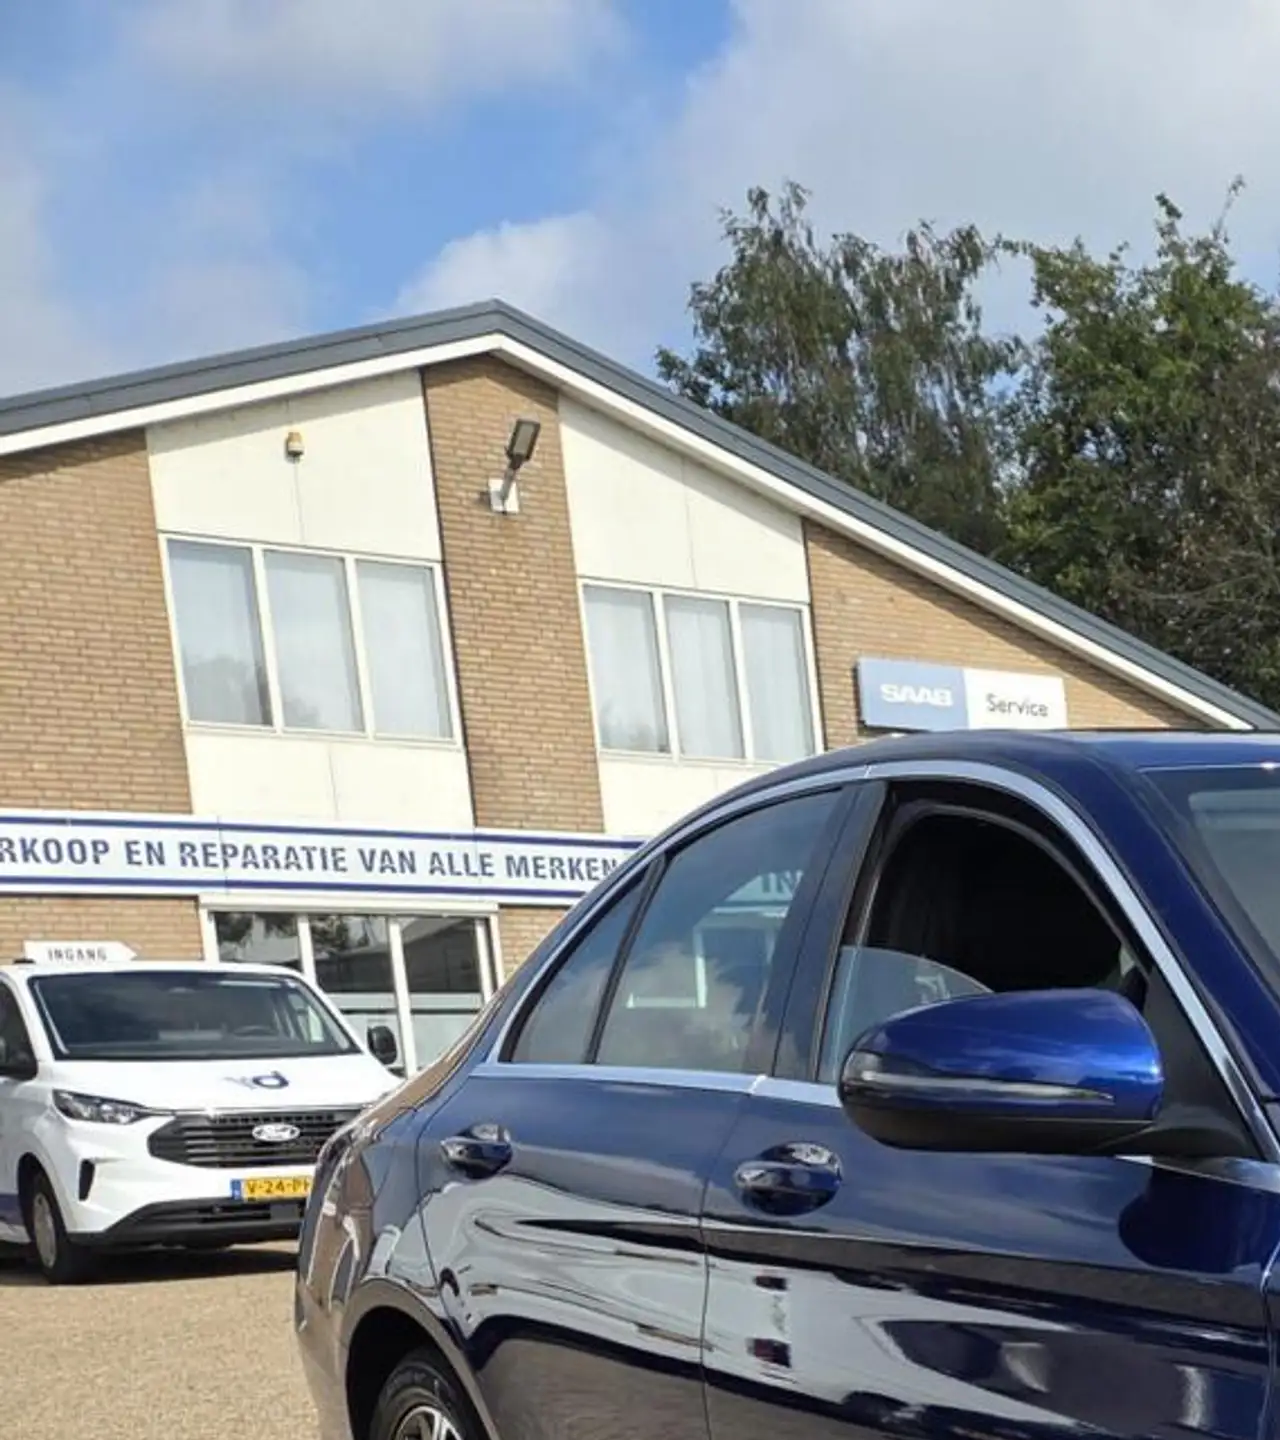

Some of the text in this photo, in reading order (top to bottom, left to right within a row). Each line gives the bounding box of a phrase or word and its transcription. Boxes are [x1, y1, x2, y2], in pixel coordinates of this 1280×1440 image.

[880, 684, 1049, 717] SAAB Service
[125, 839, 166, 867] EN
[179, 840, 349, 873] REPARATIE
[358, 847, 417, 875] VAN
[428, 850, 495, 878] ALLE
[48, 947, 107, 961] INGANG
